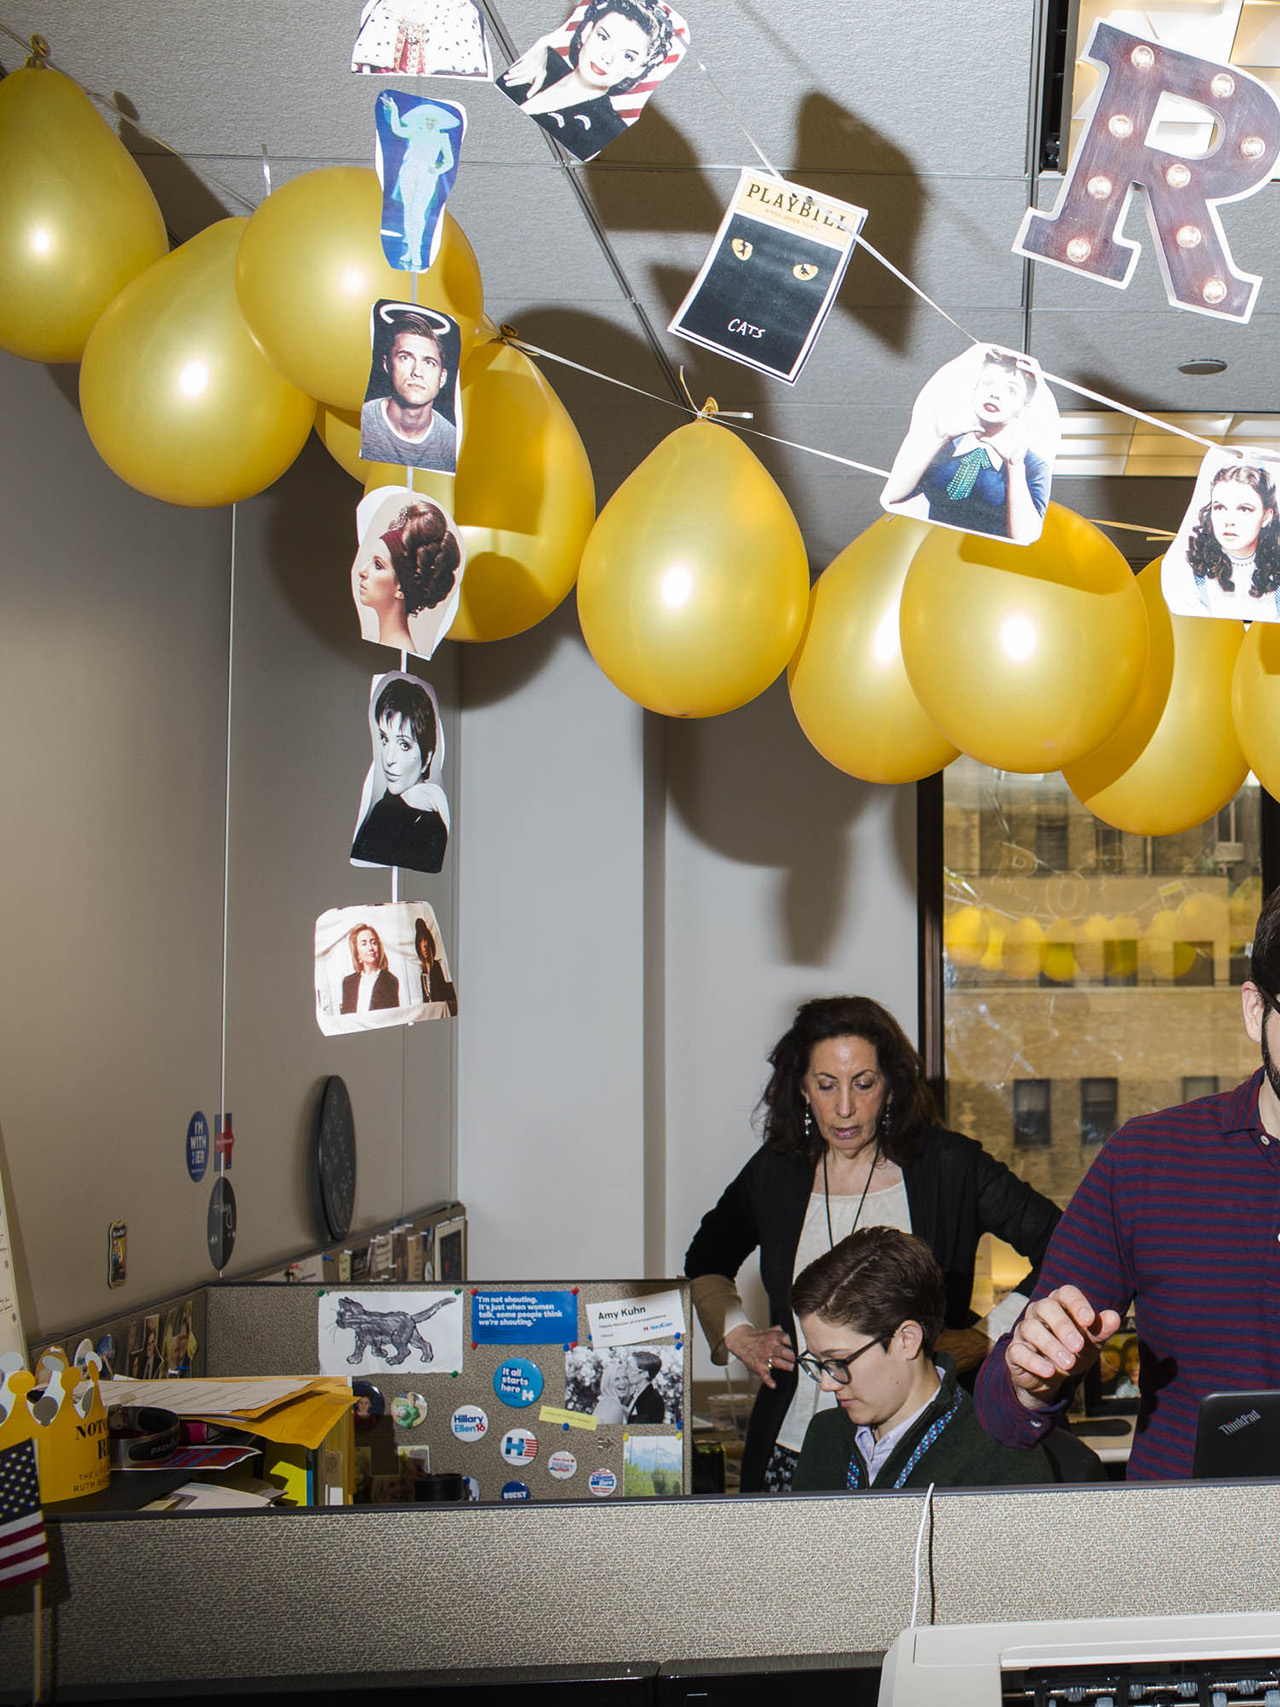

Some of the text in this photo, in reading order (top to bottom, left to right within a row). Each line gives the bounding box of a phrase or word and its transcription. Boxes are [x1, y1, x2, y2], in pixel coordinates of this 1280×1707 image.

[746, 183, 847, 232] PLAYBILL
[727, 318, 766, 339] CATS
[189, 1135, 208, 1151] WITH
[504, 1295, 538, 1305] shouting.
[479, 1303, 491, 1311] It's
[490, 1304, 506, 1313] just
[506, 1303, 527, 1311] when
[517, 1312, 543, 1321] people
[543, 1310, 563, 1318] think
[598, 1306, 646, 1321] Amy Kuhn
[502, 1367, 522, 1377] It all
[501, 1376, 529, 1386] starts
[500, 1385, 521, 1394] here
[453, 1415, 484, 1425] Hillary
[1218, 1409, 1262, 1435] ThinkPad
